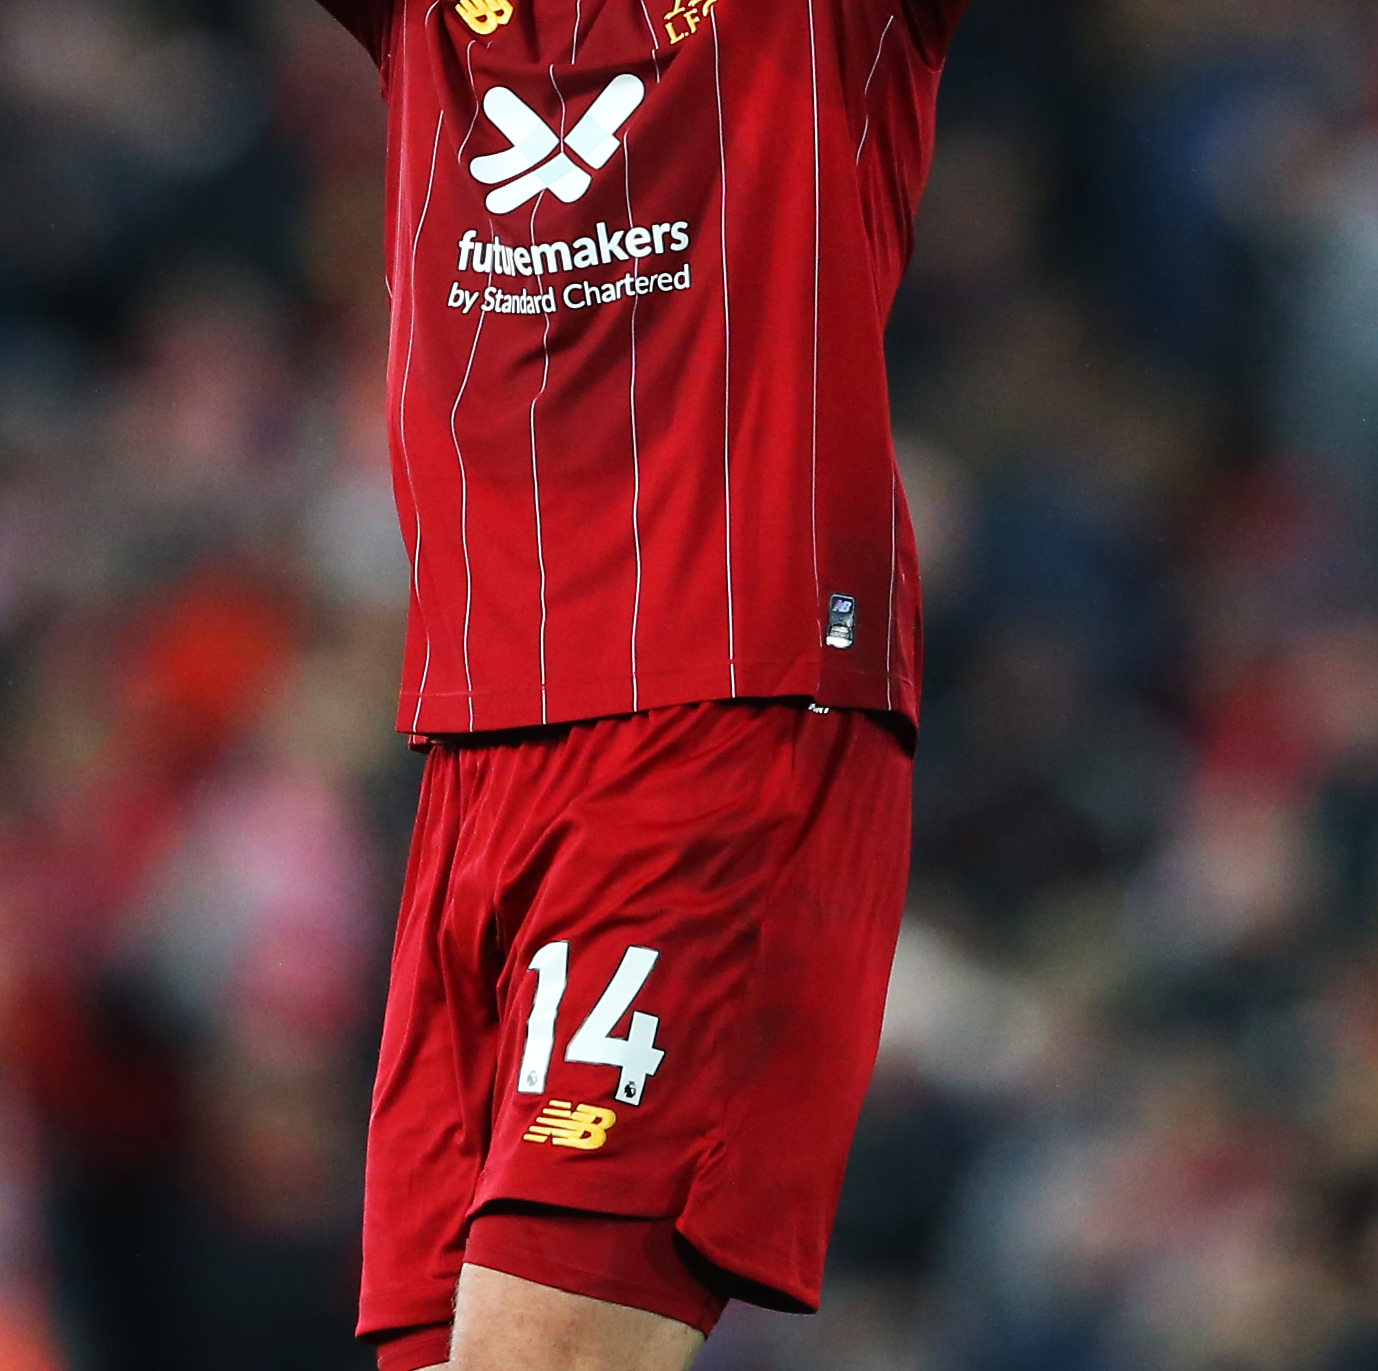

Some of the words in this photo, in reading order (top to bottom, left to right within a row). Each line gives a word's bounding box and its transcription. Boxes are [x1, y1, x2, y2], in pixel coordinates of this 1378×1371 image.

[458, 220, 689, 277] futuremakers
[447, 281, 480, 314] by
[480, 286, 557, 314] Standard
[562, 263, 692, 309] Chartered
[516, 939, 665, 1106] 14
